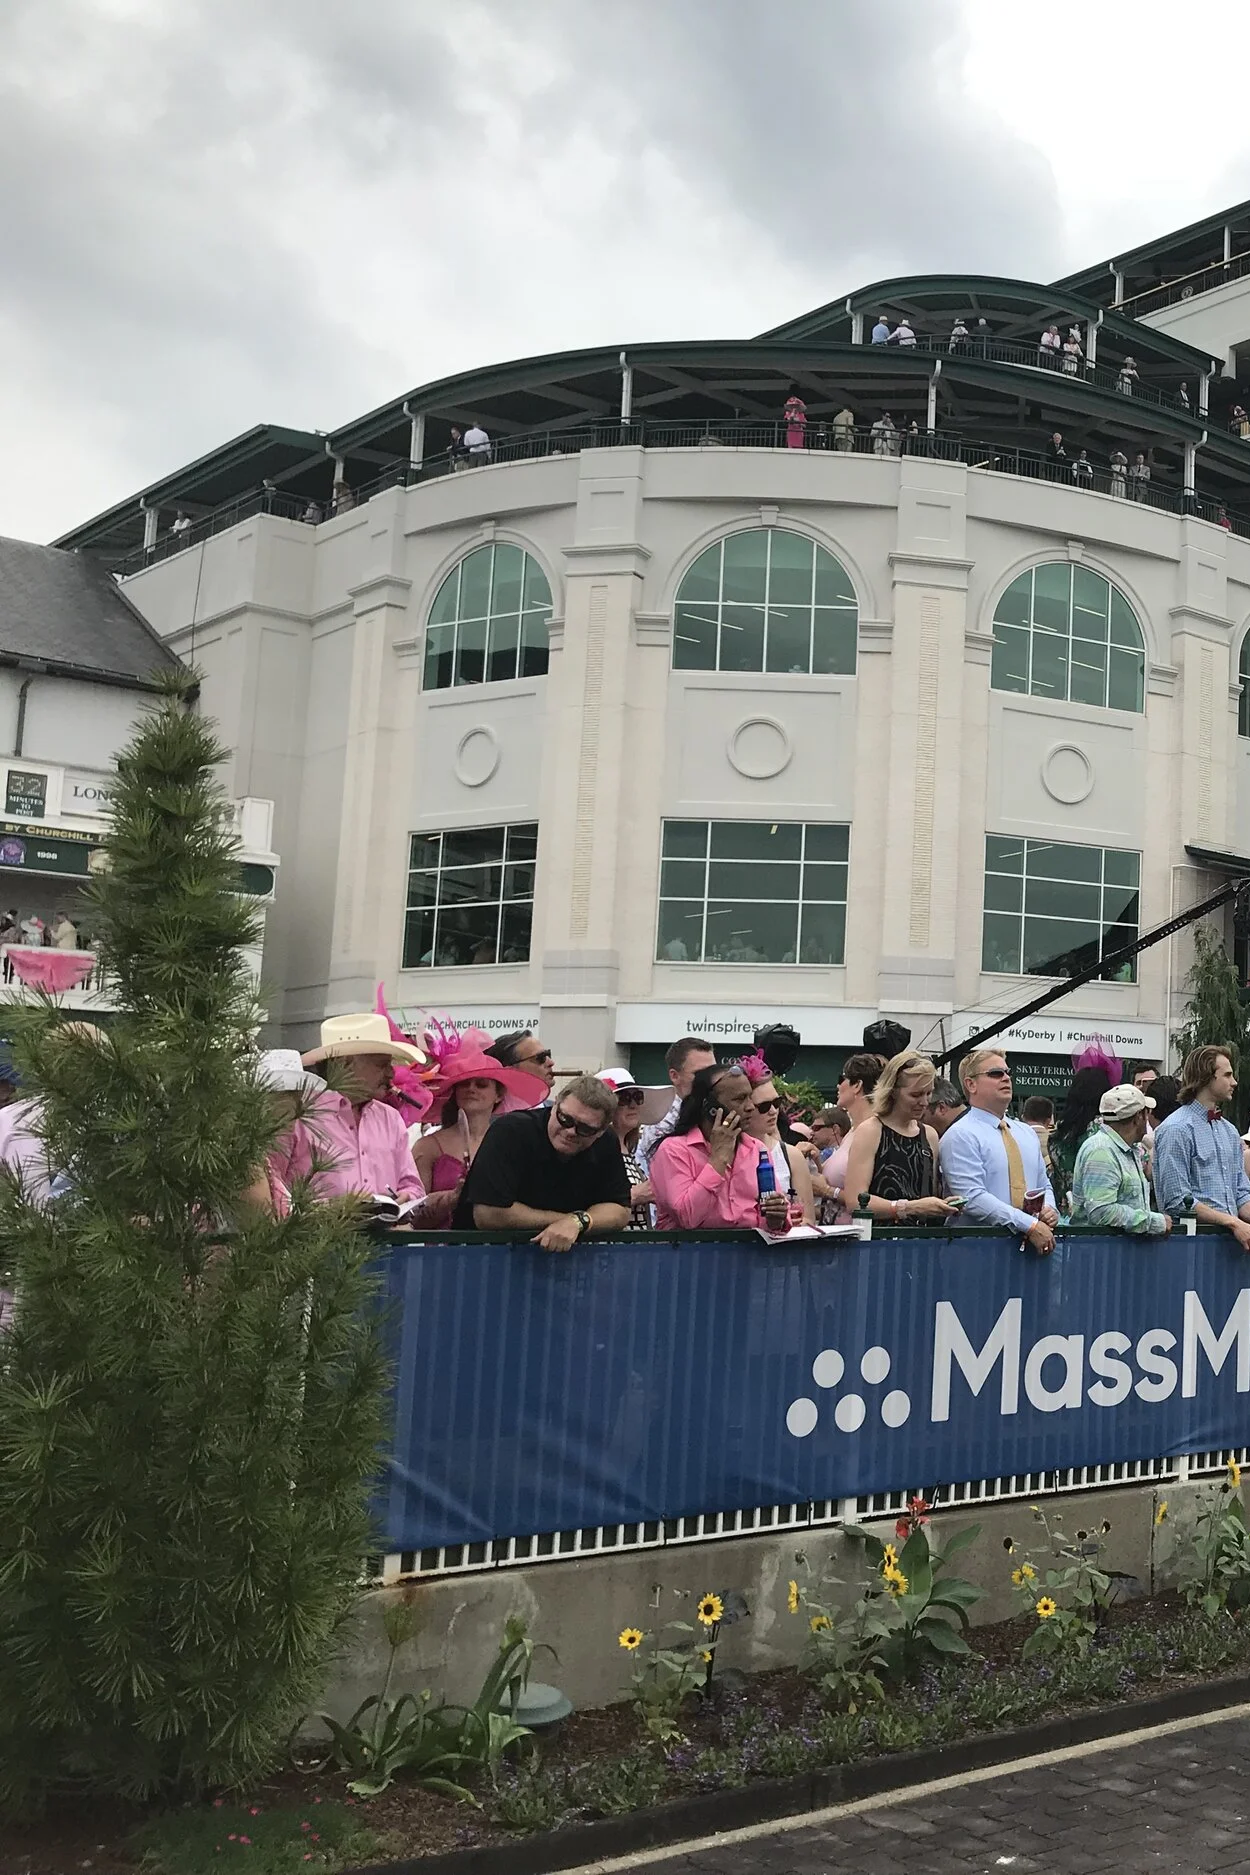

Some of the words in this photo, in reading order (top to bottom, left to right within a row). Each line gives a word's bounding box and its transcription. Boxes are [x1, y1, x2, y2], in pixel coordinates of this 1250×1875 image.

[9, 794, 44, 806] MINUTES
[15, 808, 34, 817] POST
[5, 823, 20, 832] BY
[26, 825, 94, 842] CHURCHILL
[489, 1020, 524, 1029] DOWNS
[1008, 1029, 1056, 1041] #KyDerby
[1066, 1032, 1113, 1043] #Churchill
[1115, 1035, 1143, 1045] Downs
[1016, 1065, 1040, 1074] SKYE
[1041, 1066, 1076, 1076] TERRAC
[1015, 1076, 1060, 1087] SECTIONS
